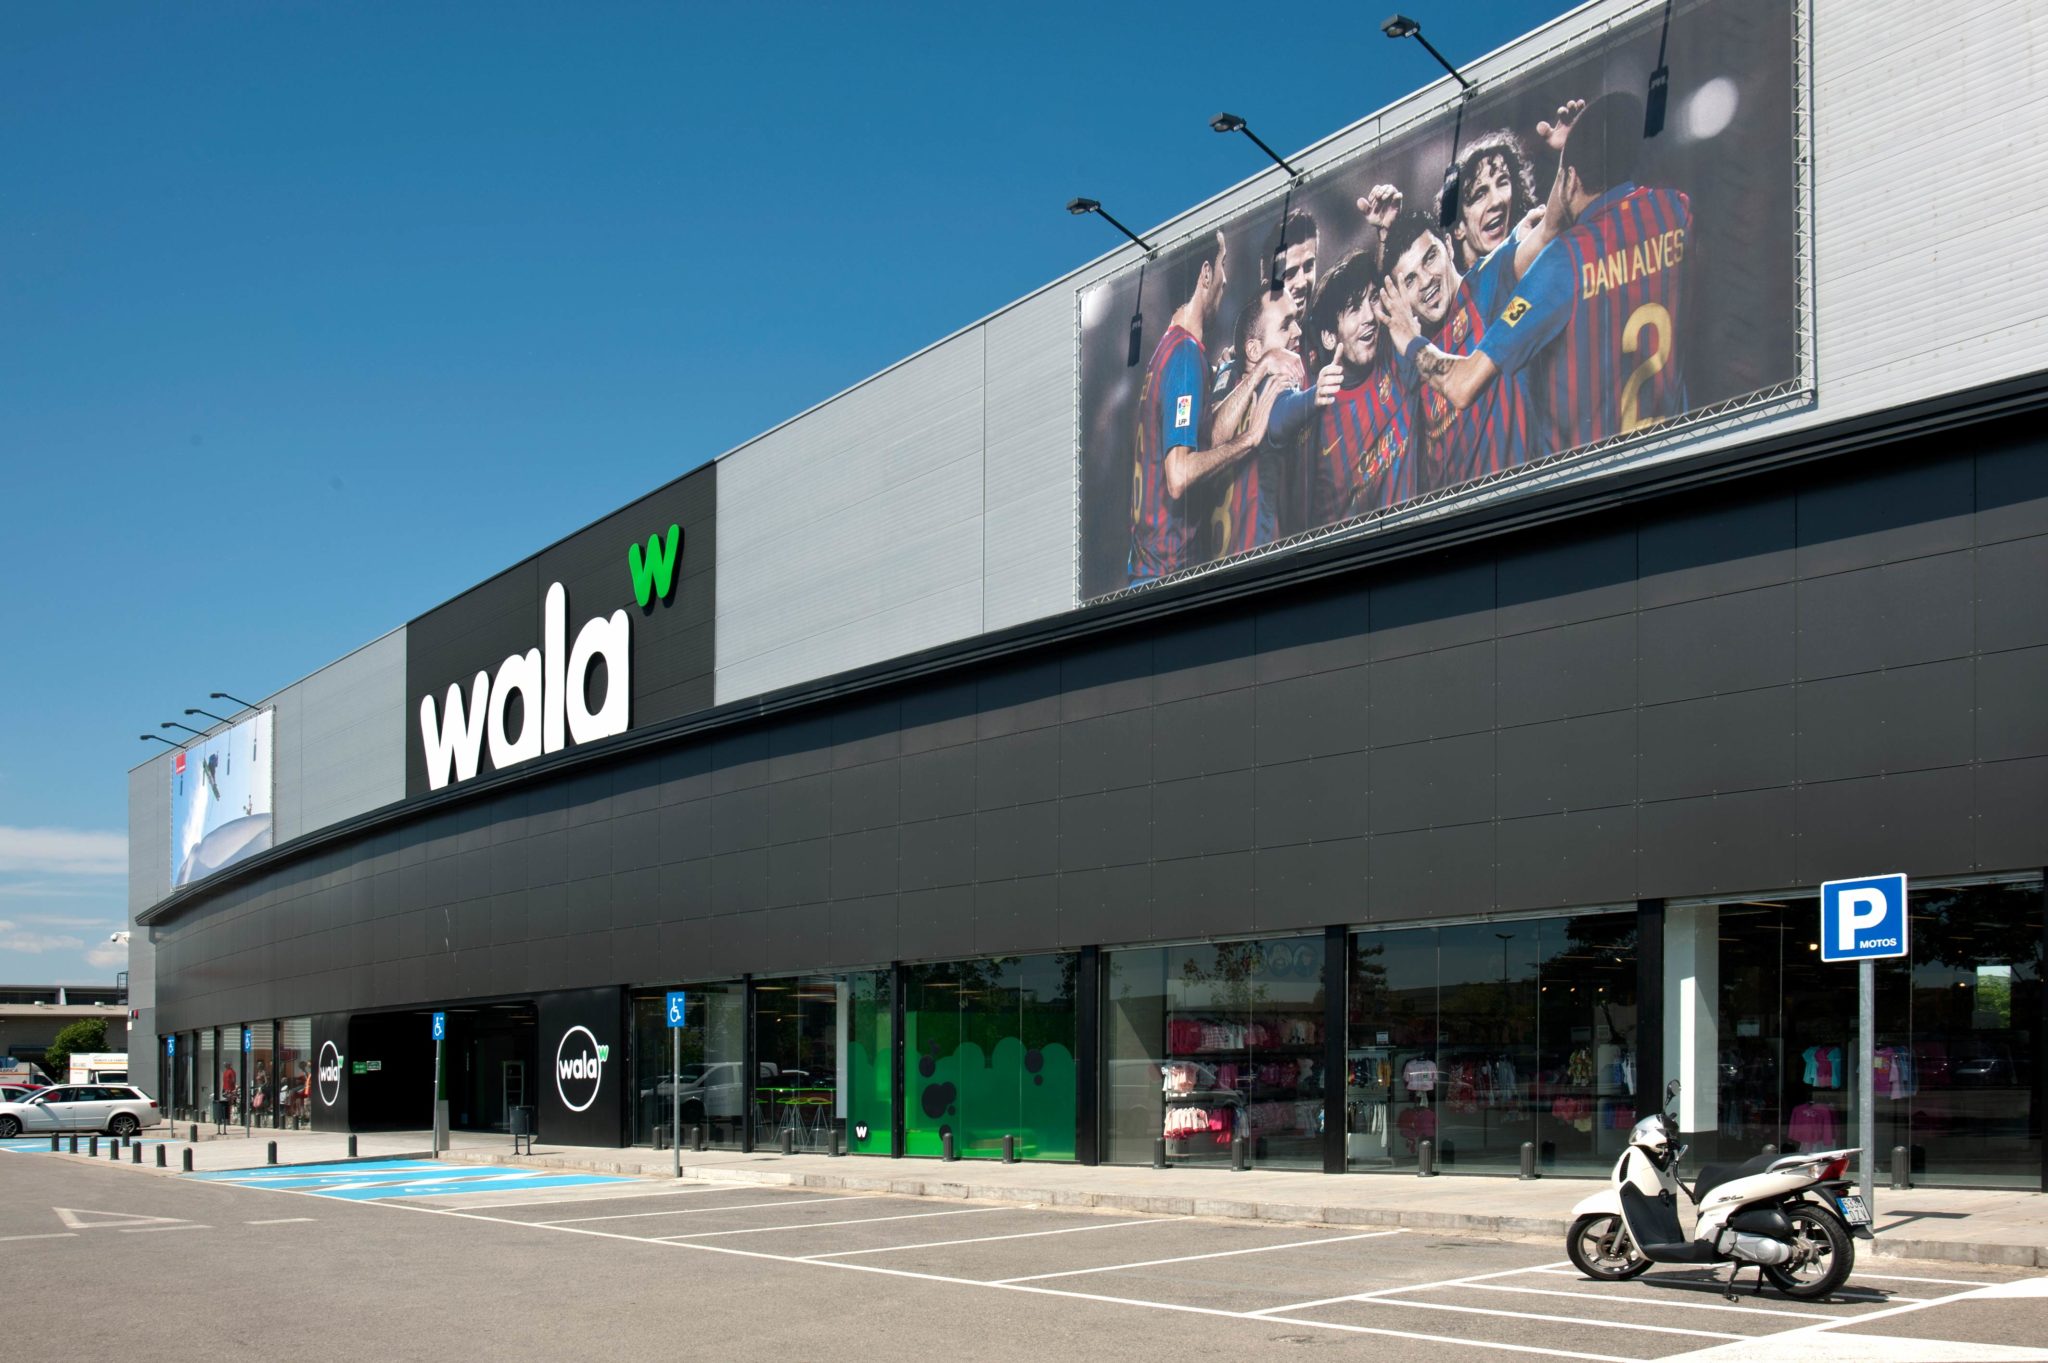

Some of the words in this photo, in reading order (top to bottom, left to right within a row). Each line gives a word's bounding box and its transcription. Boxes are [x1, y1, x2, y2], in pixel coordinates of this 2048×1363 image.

[1582, 249, 1627, 299] DANI
[1632, 229, 1684, 281] ALVES
[1621, 303, 1671, 434] 2
[420, 582, 629, 791] wala
[629, 524, 679, 607] w
[1839, 887, 1887, 951] P
[1860, 938, 1897, 949] MOTOS
[320, 1059, 338, 1082] wala
[560, 1050, 598, 1079] wala
